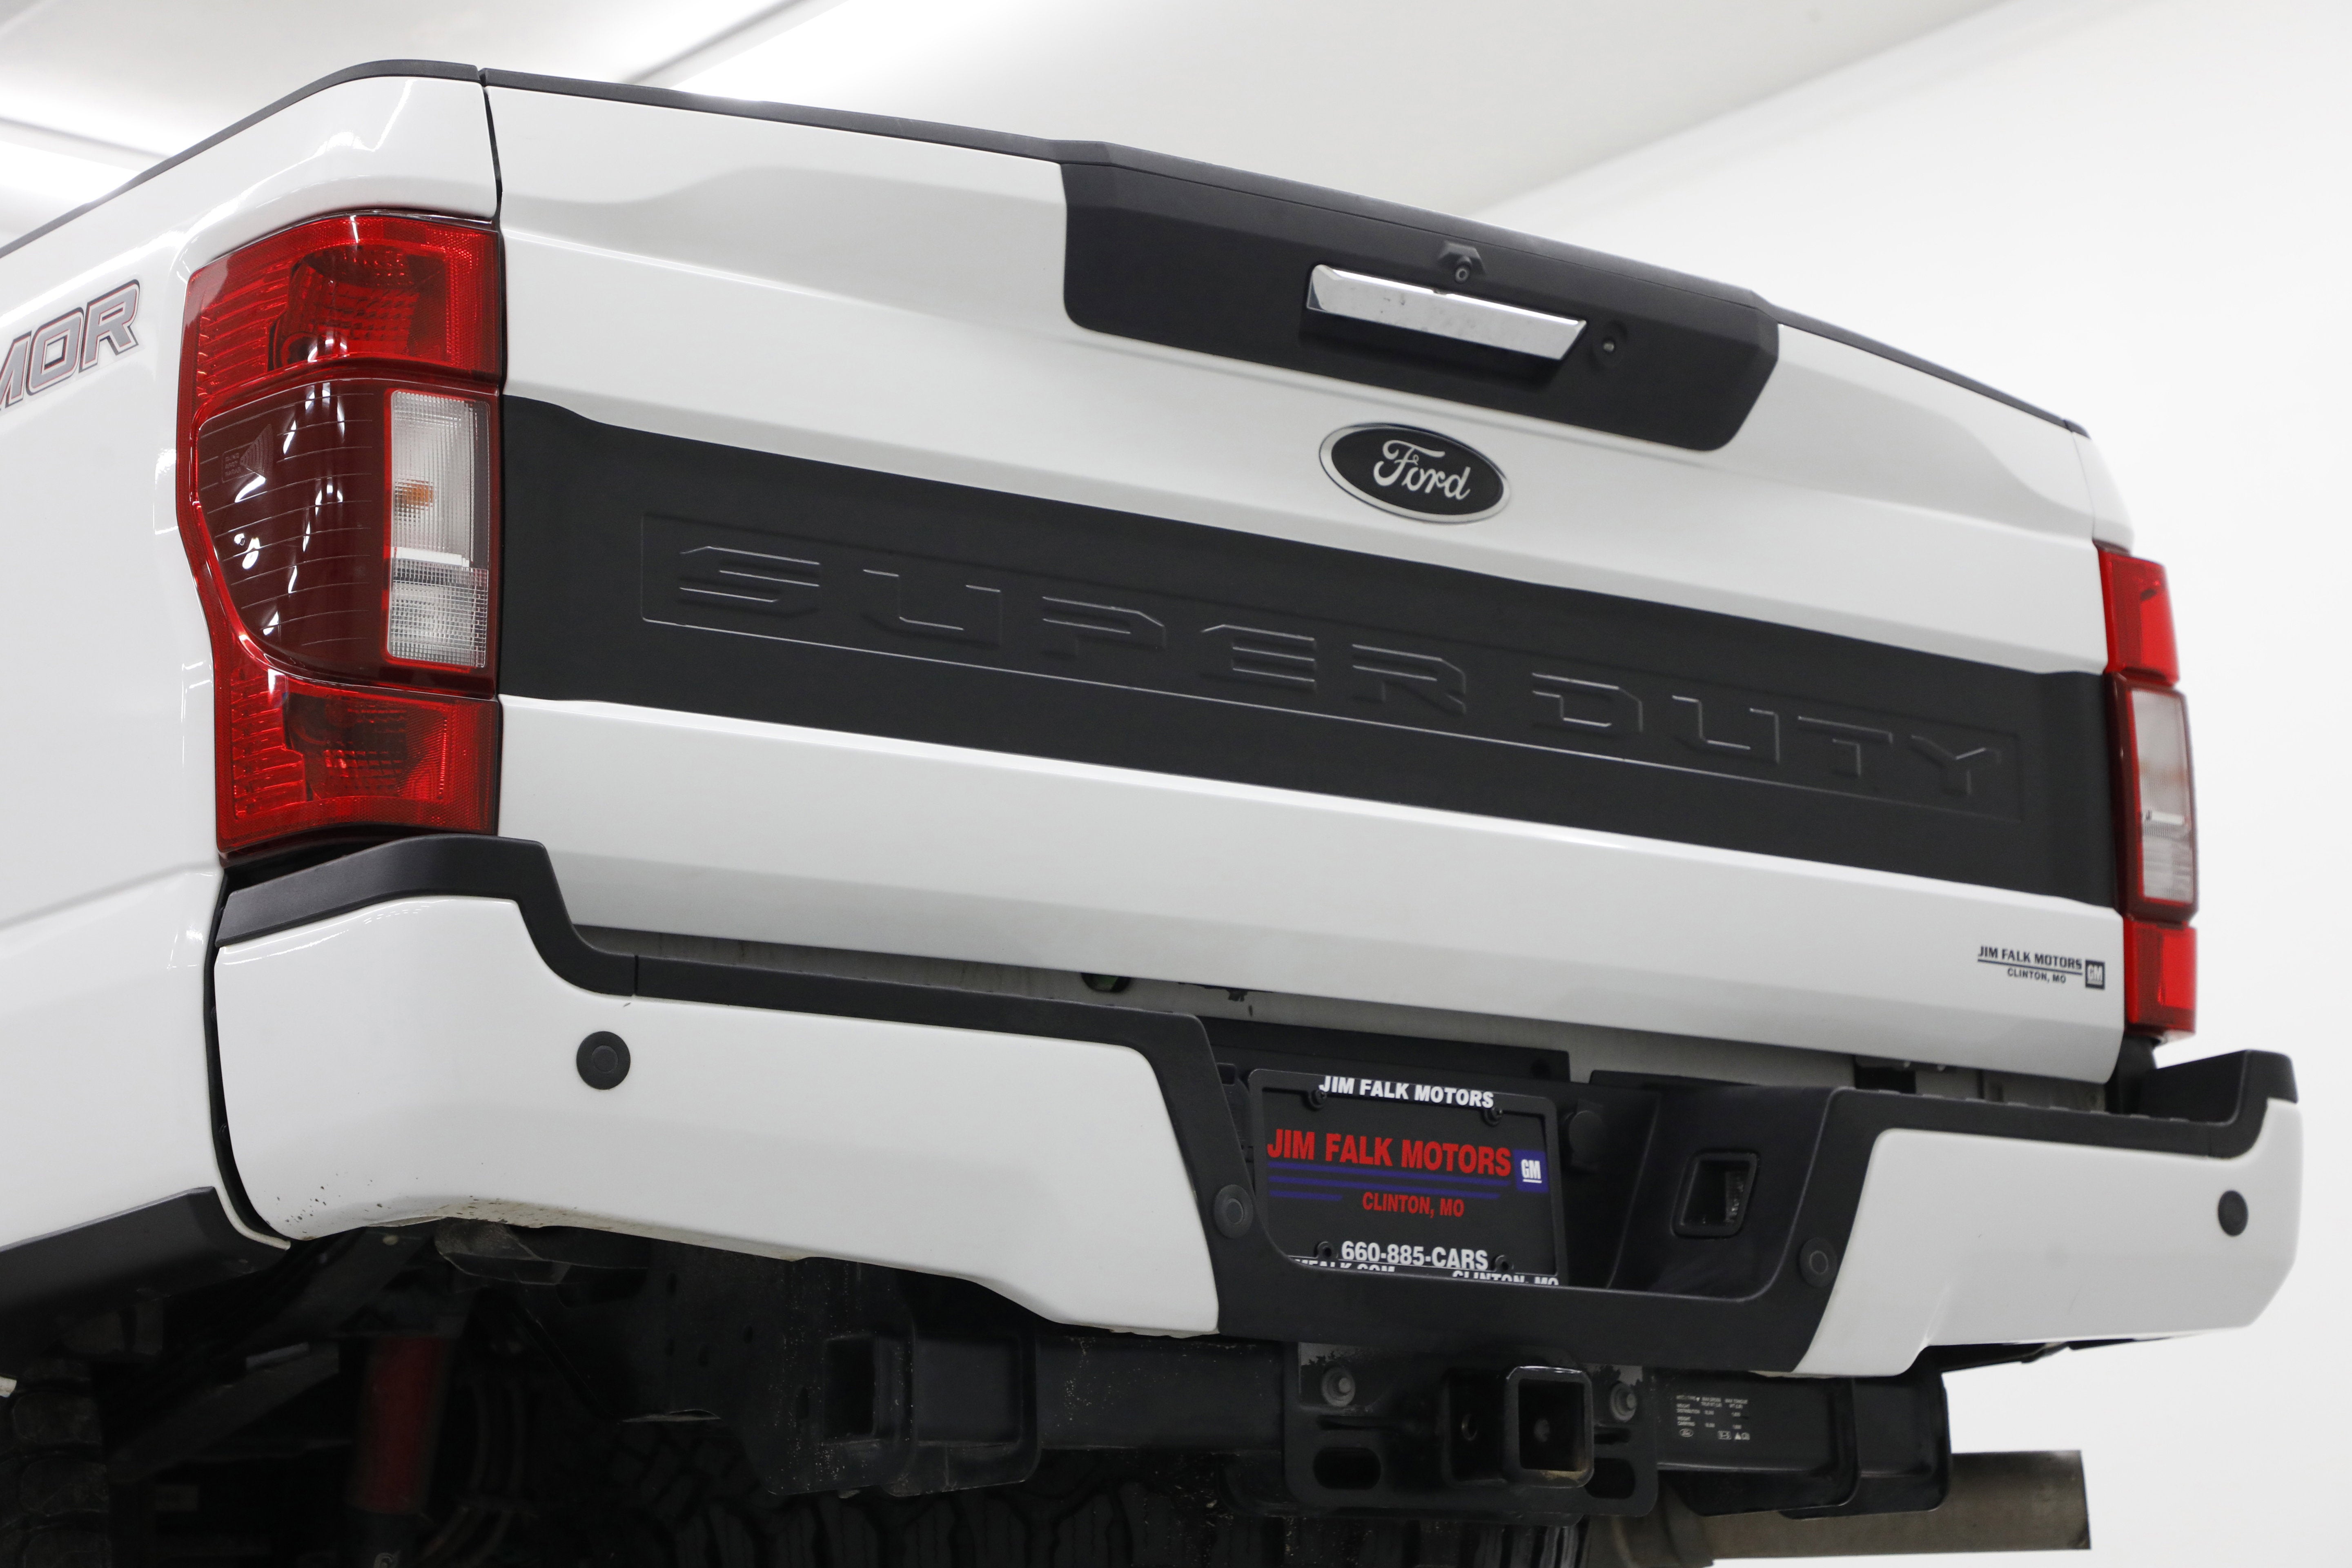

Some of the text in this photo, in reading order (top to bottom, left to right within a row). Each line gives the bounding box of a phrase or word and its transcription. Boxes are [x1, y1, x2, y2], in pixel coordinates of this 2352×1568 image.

[1373, 440, 1471, 504] Ford
[678, 546, 2002, 795] SUPER DUTY
[1978, 946, 2082, 970] JIM FALK MOTORS
[2052, 974, 2067, 984] MO
[1319, 1075, 1494, 1108] JIM FALK MOTORS
[1267, 1129, 1511, 1176] JIM FALK MOTORS
[1521, 1159, 1541, 1180] GM
[1362, 1192, 1465, 1218] CLINTON, MO
[1341, 1241, 1489, 1270] 660-885-CARS
